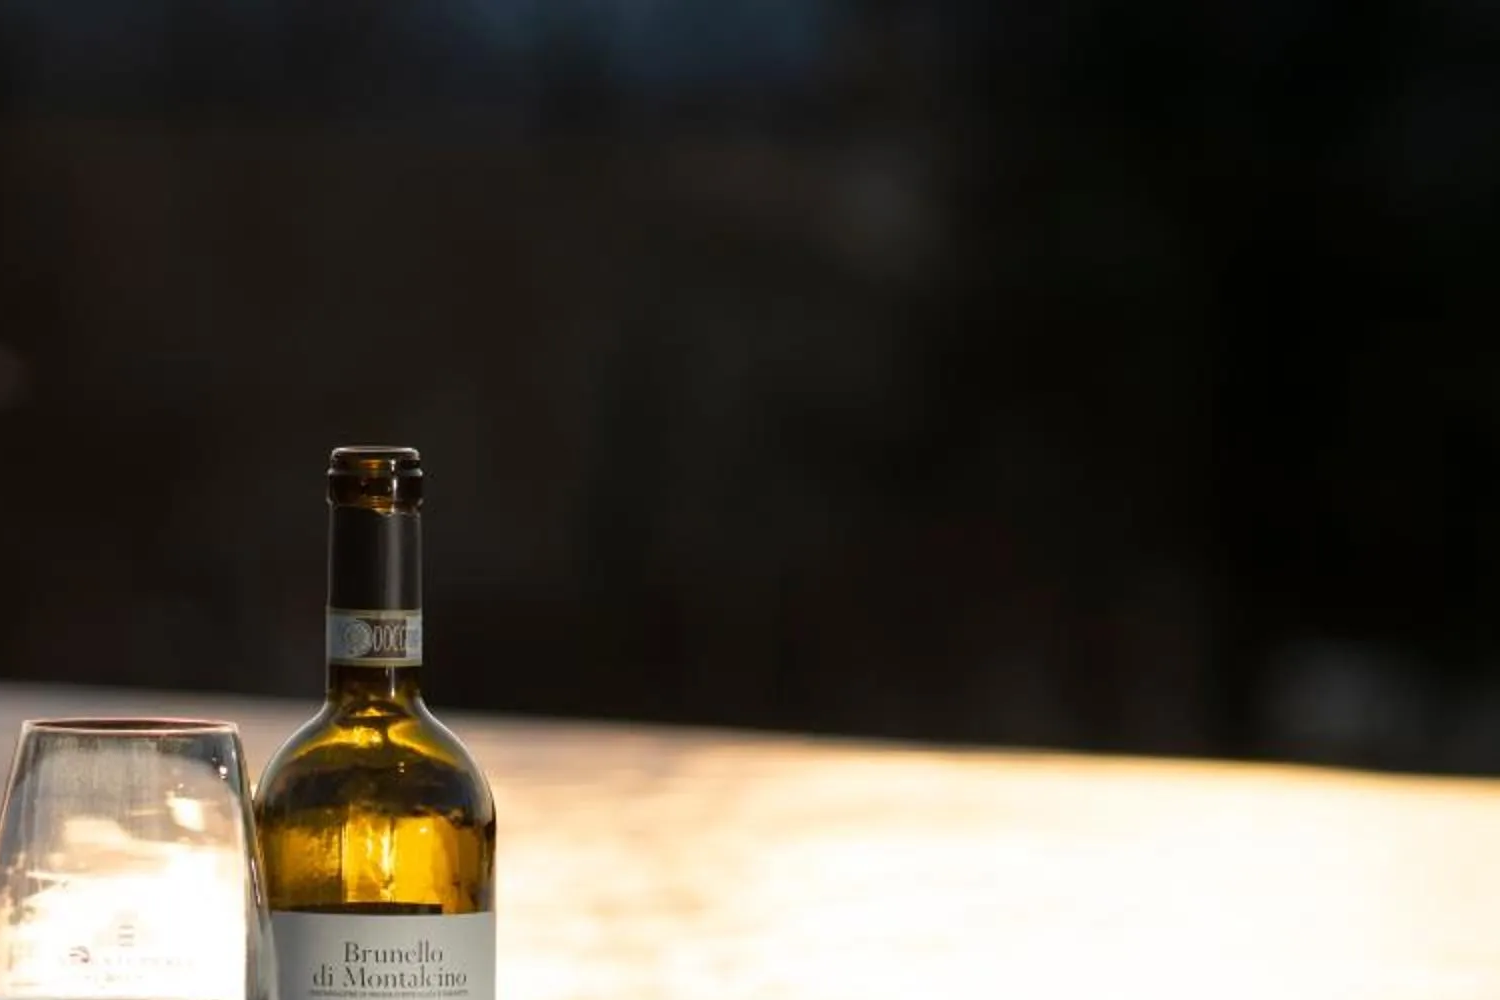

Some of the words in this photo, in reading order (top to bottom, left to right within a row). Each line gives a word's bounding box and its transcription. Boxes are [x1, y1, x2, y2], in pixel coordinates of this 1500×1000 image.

[344, 939, 444, 964] Brunello
[312, 964, 334, 987] di
[343, 964, 467, 988] Montalcino
